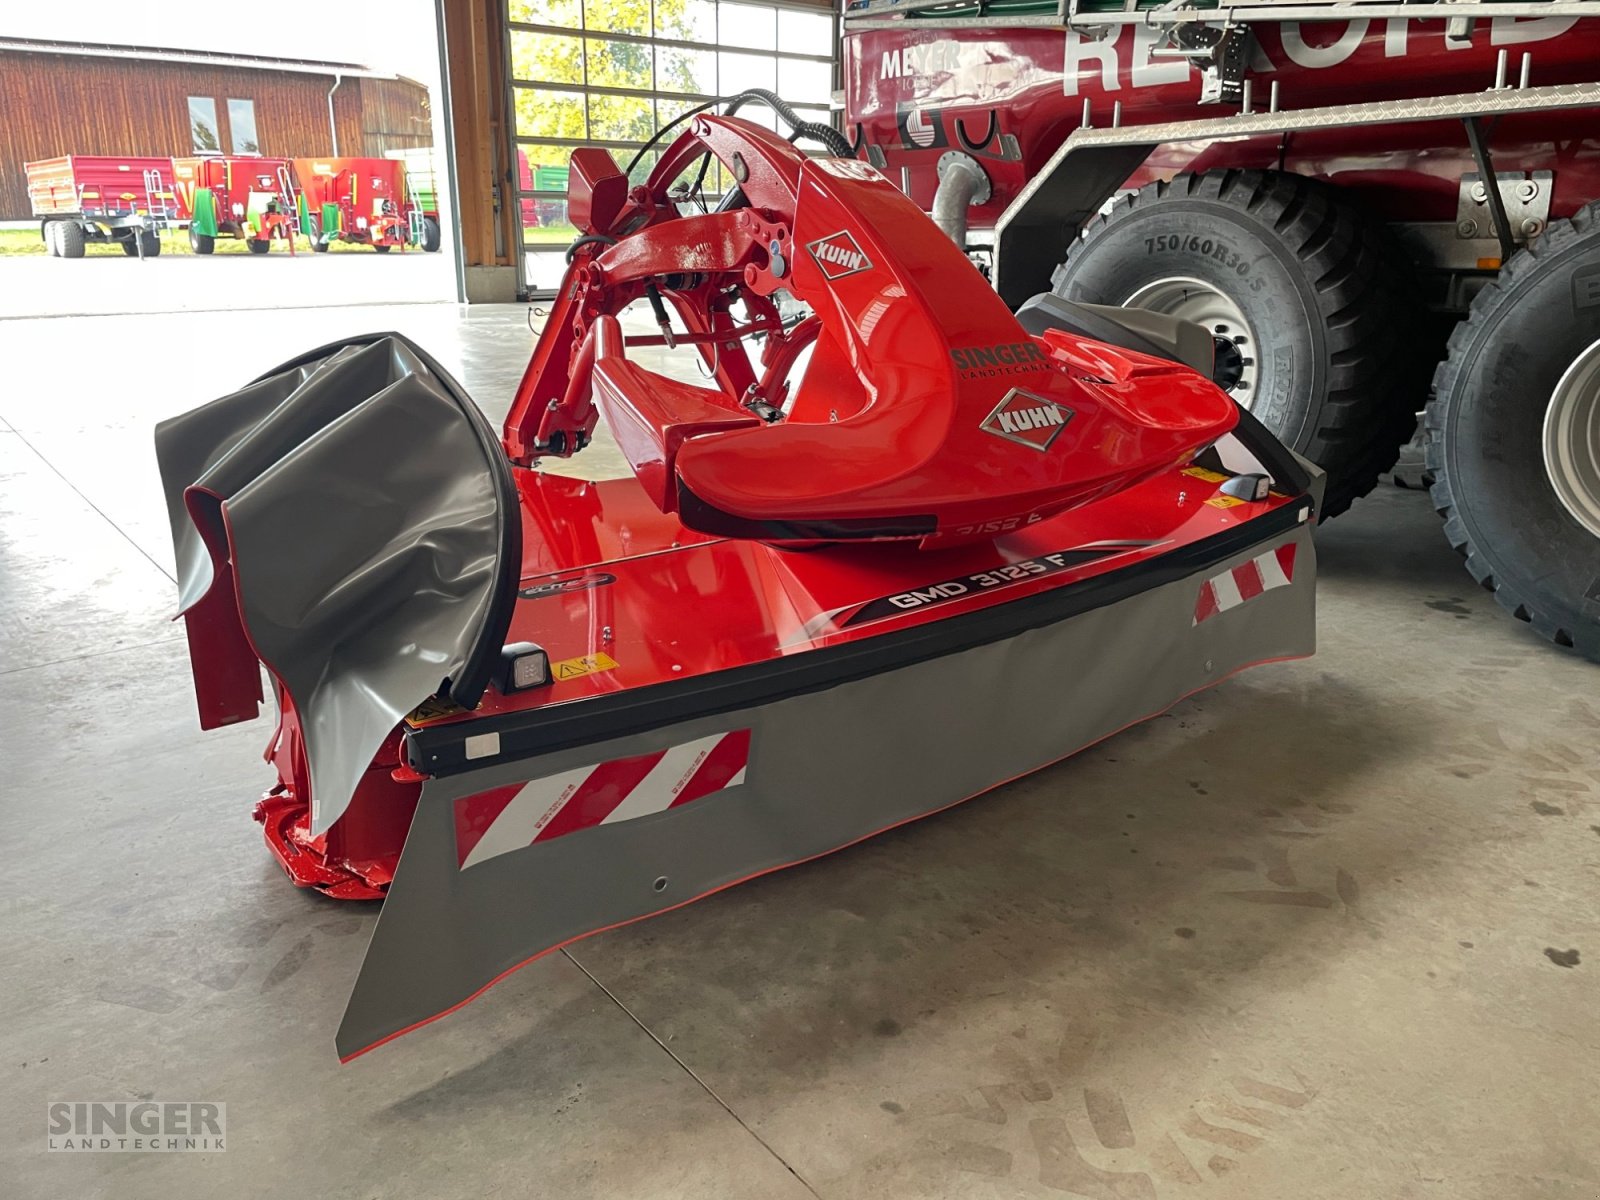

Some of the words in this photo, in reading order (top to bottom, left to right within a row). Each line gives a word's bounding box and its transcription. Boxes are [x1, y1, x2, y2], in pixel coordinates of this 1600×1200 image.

[880, 41, 961, 80] MEYER
[815, 242, 863, 270] KUHN
[950, 342, 1047, 370] SINGER
[961, 364, 1052, 380] LANDTECHNIK
[996, 404, 1064, 433] KUHN
[888, 582, 968, 609] GMD
[970, 560, 1041, 587] 3125
[1045, 554, 1066, 567] F
